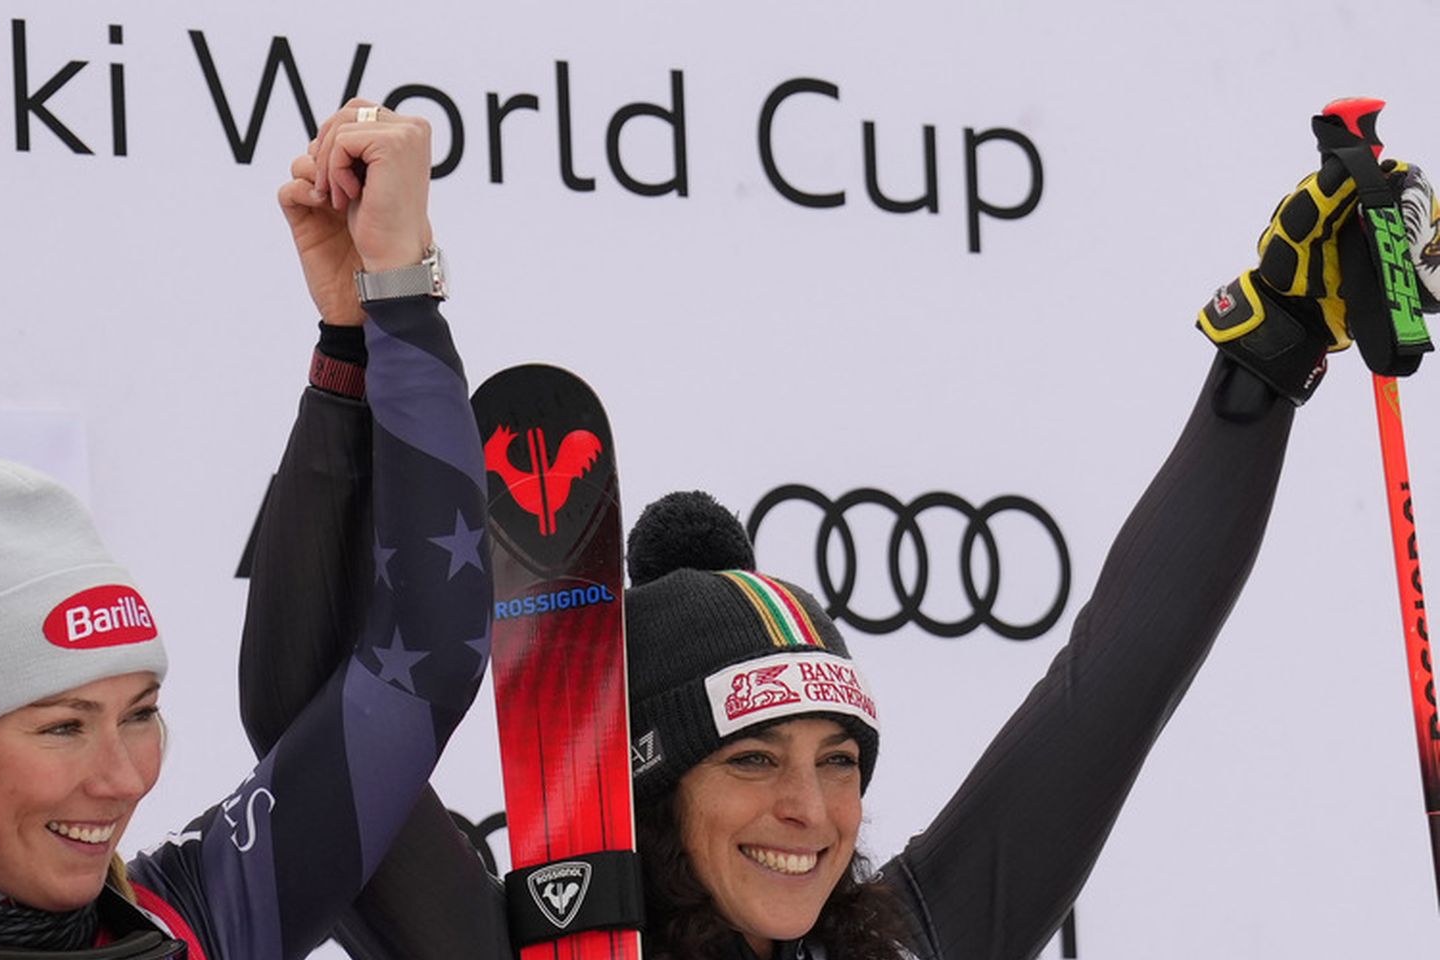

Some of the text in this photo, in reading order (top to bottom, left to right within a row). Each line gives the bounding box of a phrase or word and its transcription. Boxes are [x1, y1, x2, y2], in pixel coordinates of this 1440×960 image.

[188, 29, 689, 198] World
[756, 77, 1044, 254] Cup
[66, 597, 153, 642] Barilla
[494, 583, 615, 620] ROSSIGNOL
[797, 662, 862, 690] BANCA
